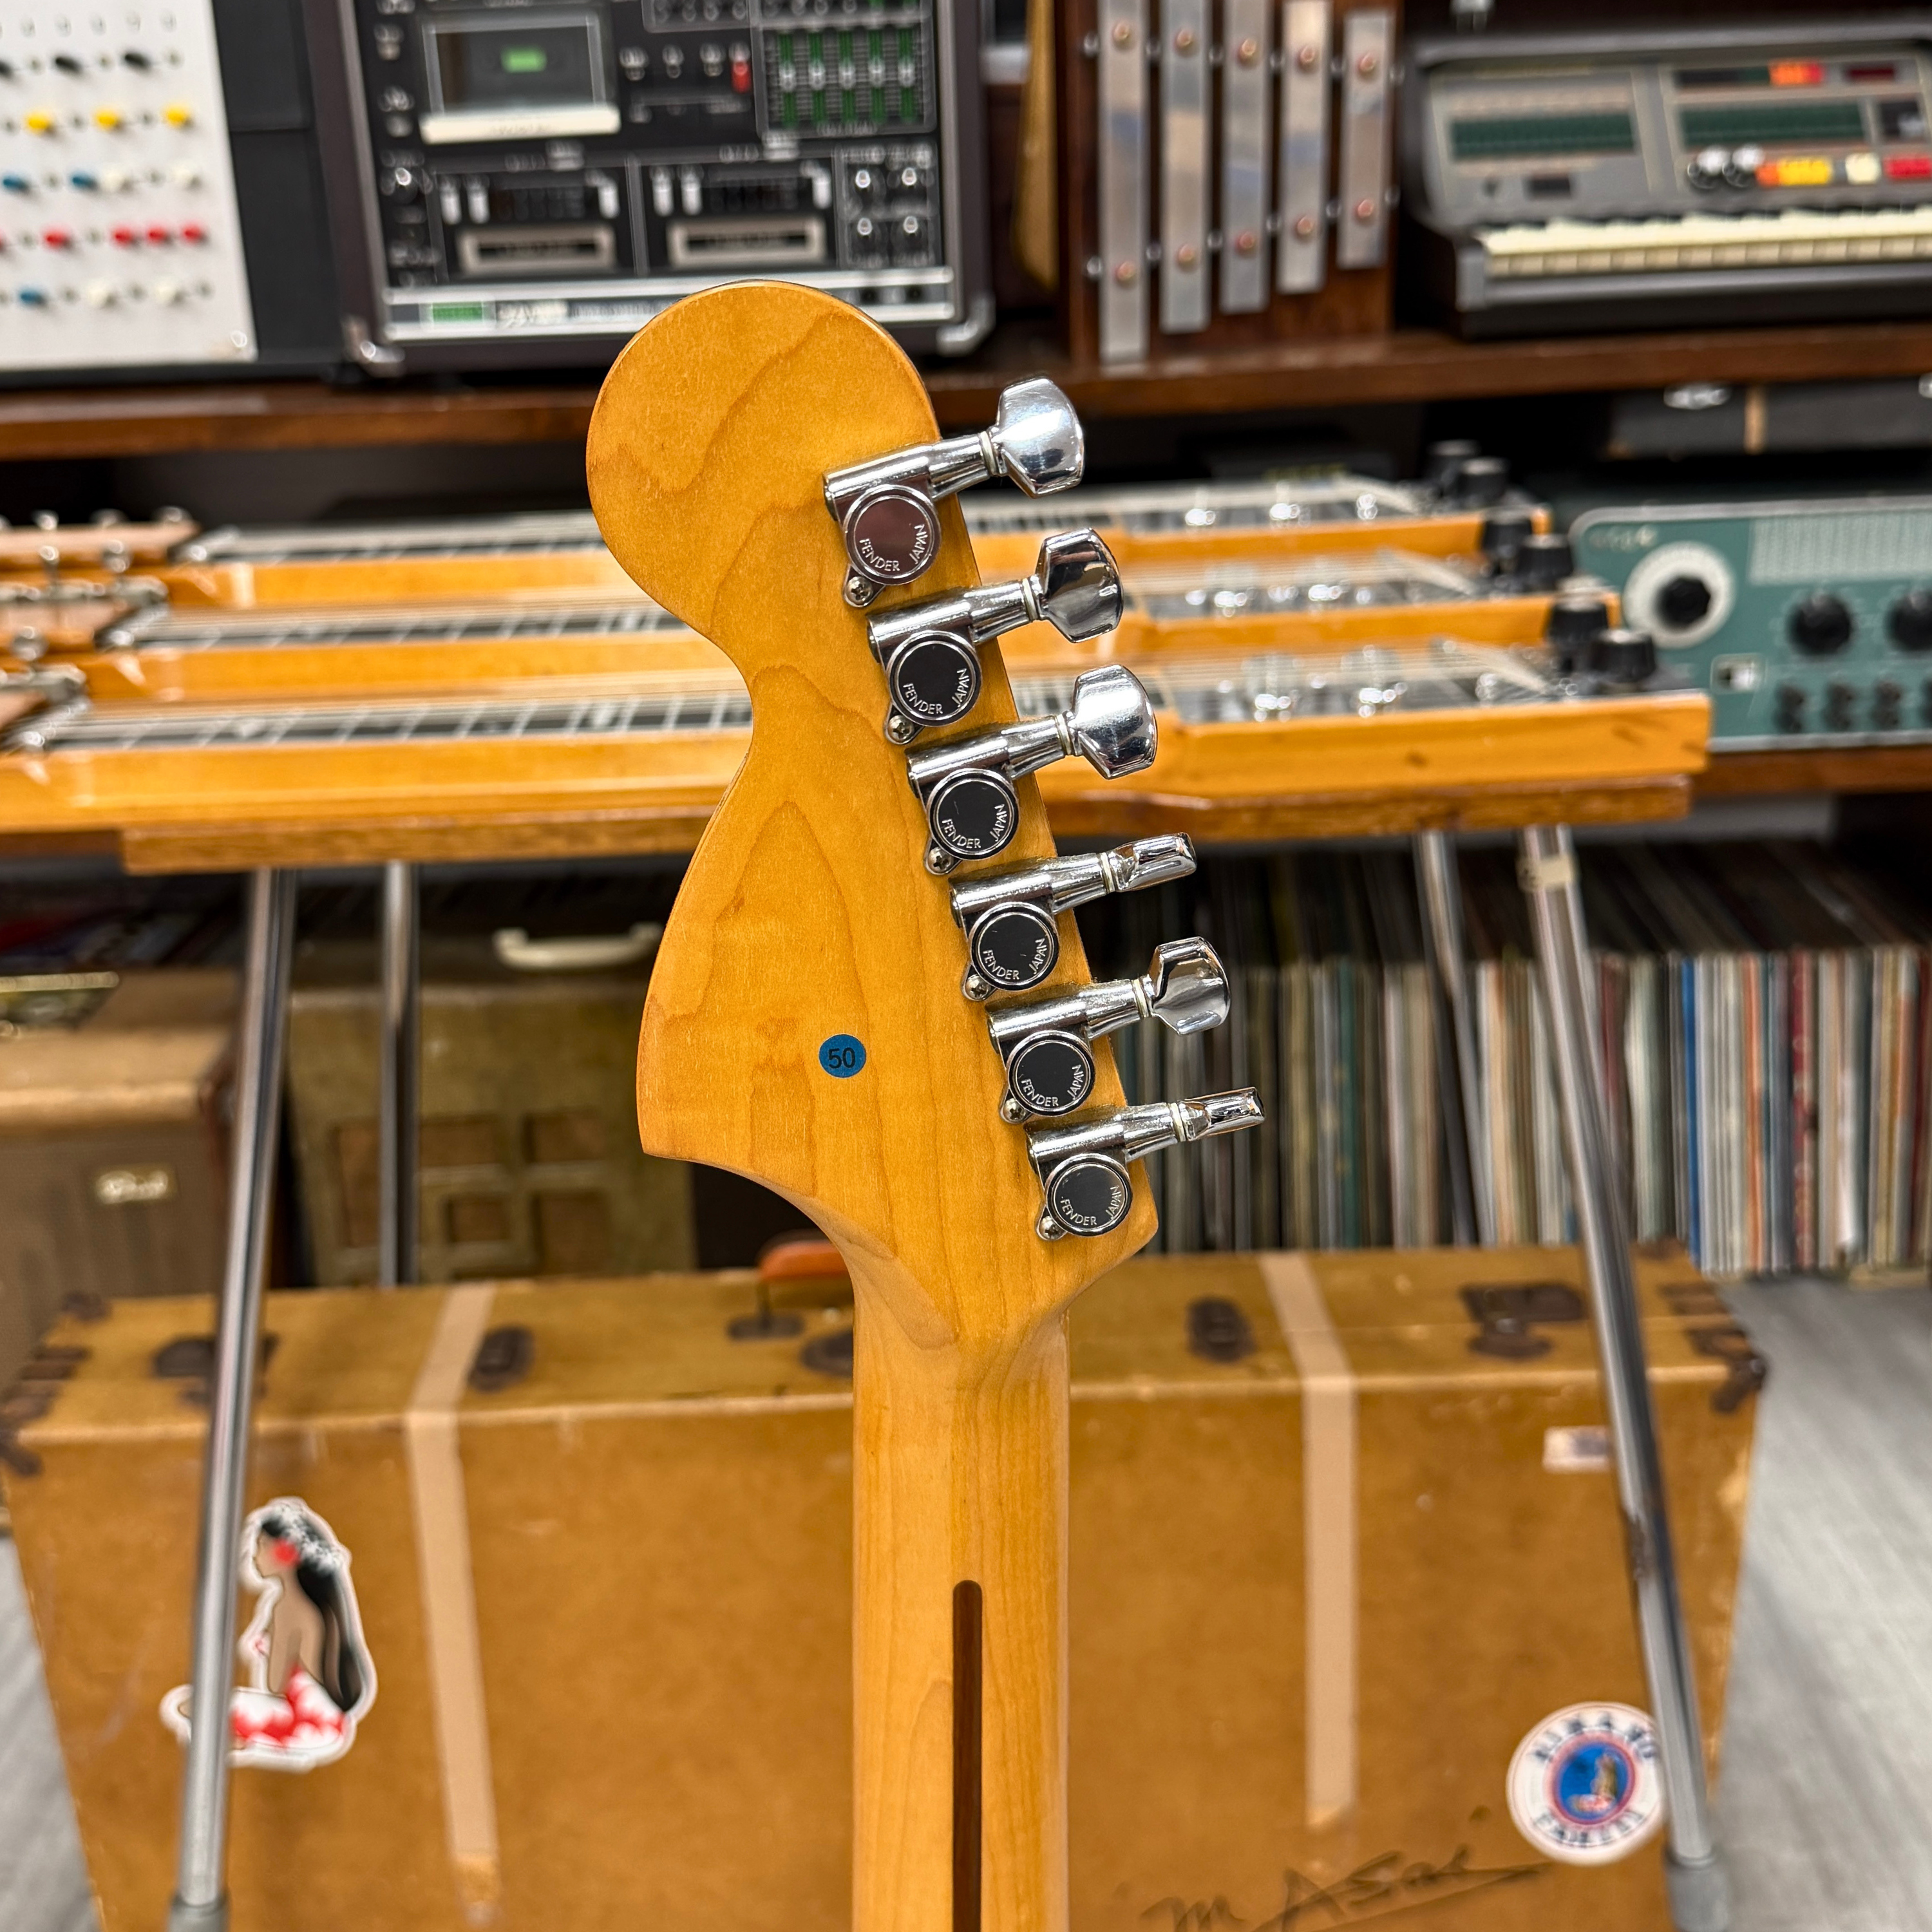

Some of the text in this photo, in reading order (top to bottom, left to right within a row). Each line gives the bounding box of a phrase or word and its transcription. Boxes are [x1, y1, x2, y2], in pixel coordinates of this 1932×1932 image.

[860, 524, 928, 572] FENDER JAPAN
[903, 668, 971, 715] FENDER JAPAN
[942, 804, 1008, 849] FENDER JAPAN
[983, 938, 1048, 980] FENDER JAPAN
[828, 1047, 855, 1069] 50
[1021, 1064, 1085, 1107] FENDER JAPAN
[1061, 1185, 1122, 1226] FENDER JAPAN
